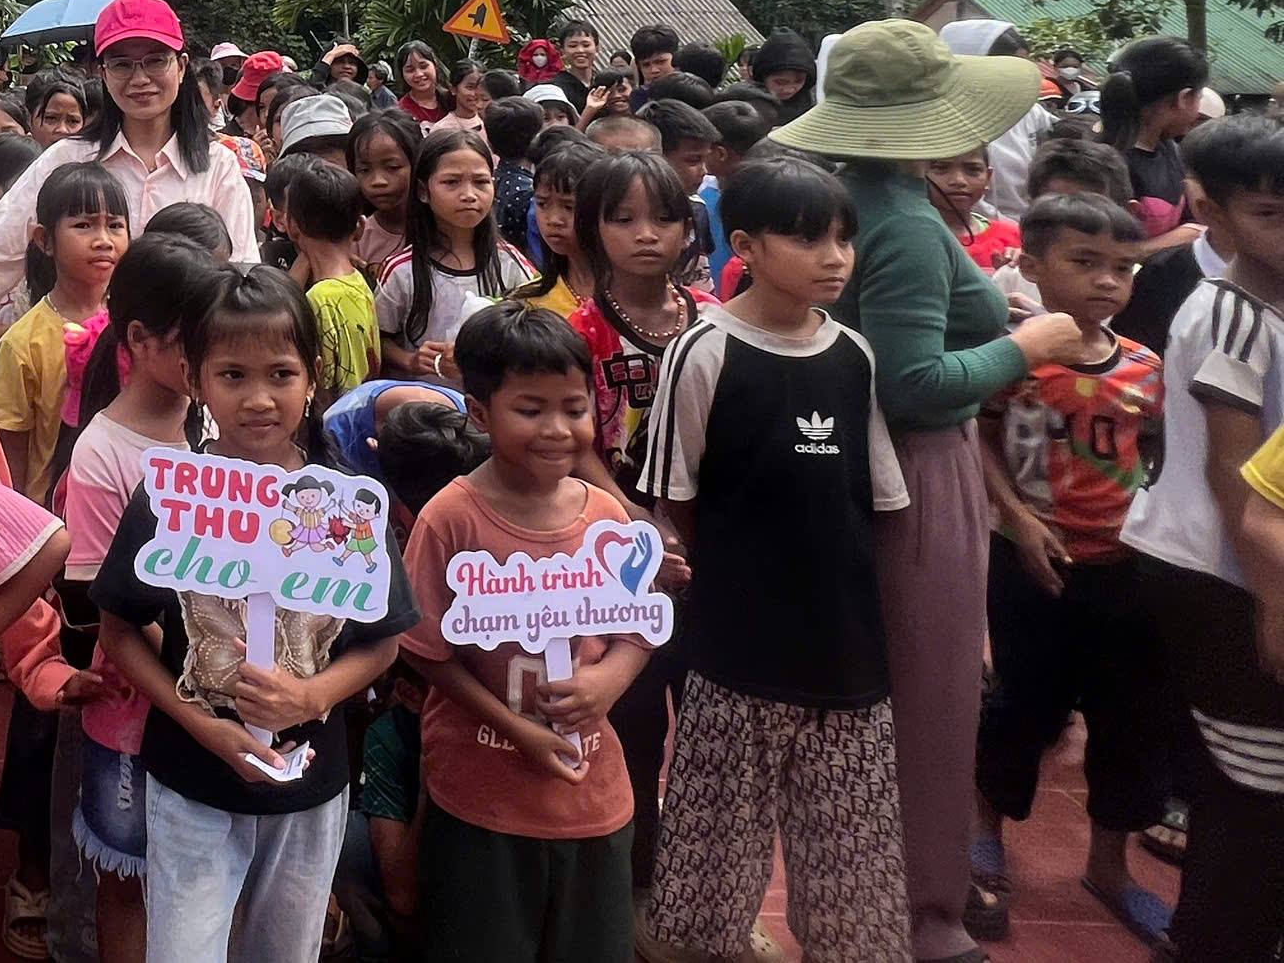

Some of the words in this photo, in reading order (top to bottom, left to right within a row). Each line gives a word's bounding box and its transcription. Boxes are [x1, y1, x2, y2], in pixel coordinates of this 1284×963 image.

[794, 442, 841, 455] adidas
[149, 457, 281, 509] TRUNG
[160, 498, 261, 544] THU
[143, 535, 258, 589] cho
[280, 571, 378, 613] em
[456, 562, 536, 597] Hành
[541, 557, 604, 591] trình
[451, 604, 520, 641] chạm
[526, 604, 571, 643] yêu
[575, 595, 664, 634] thương
